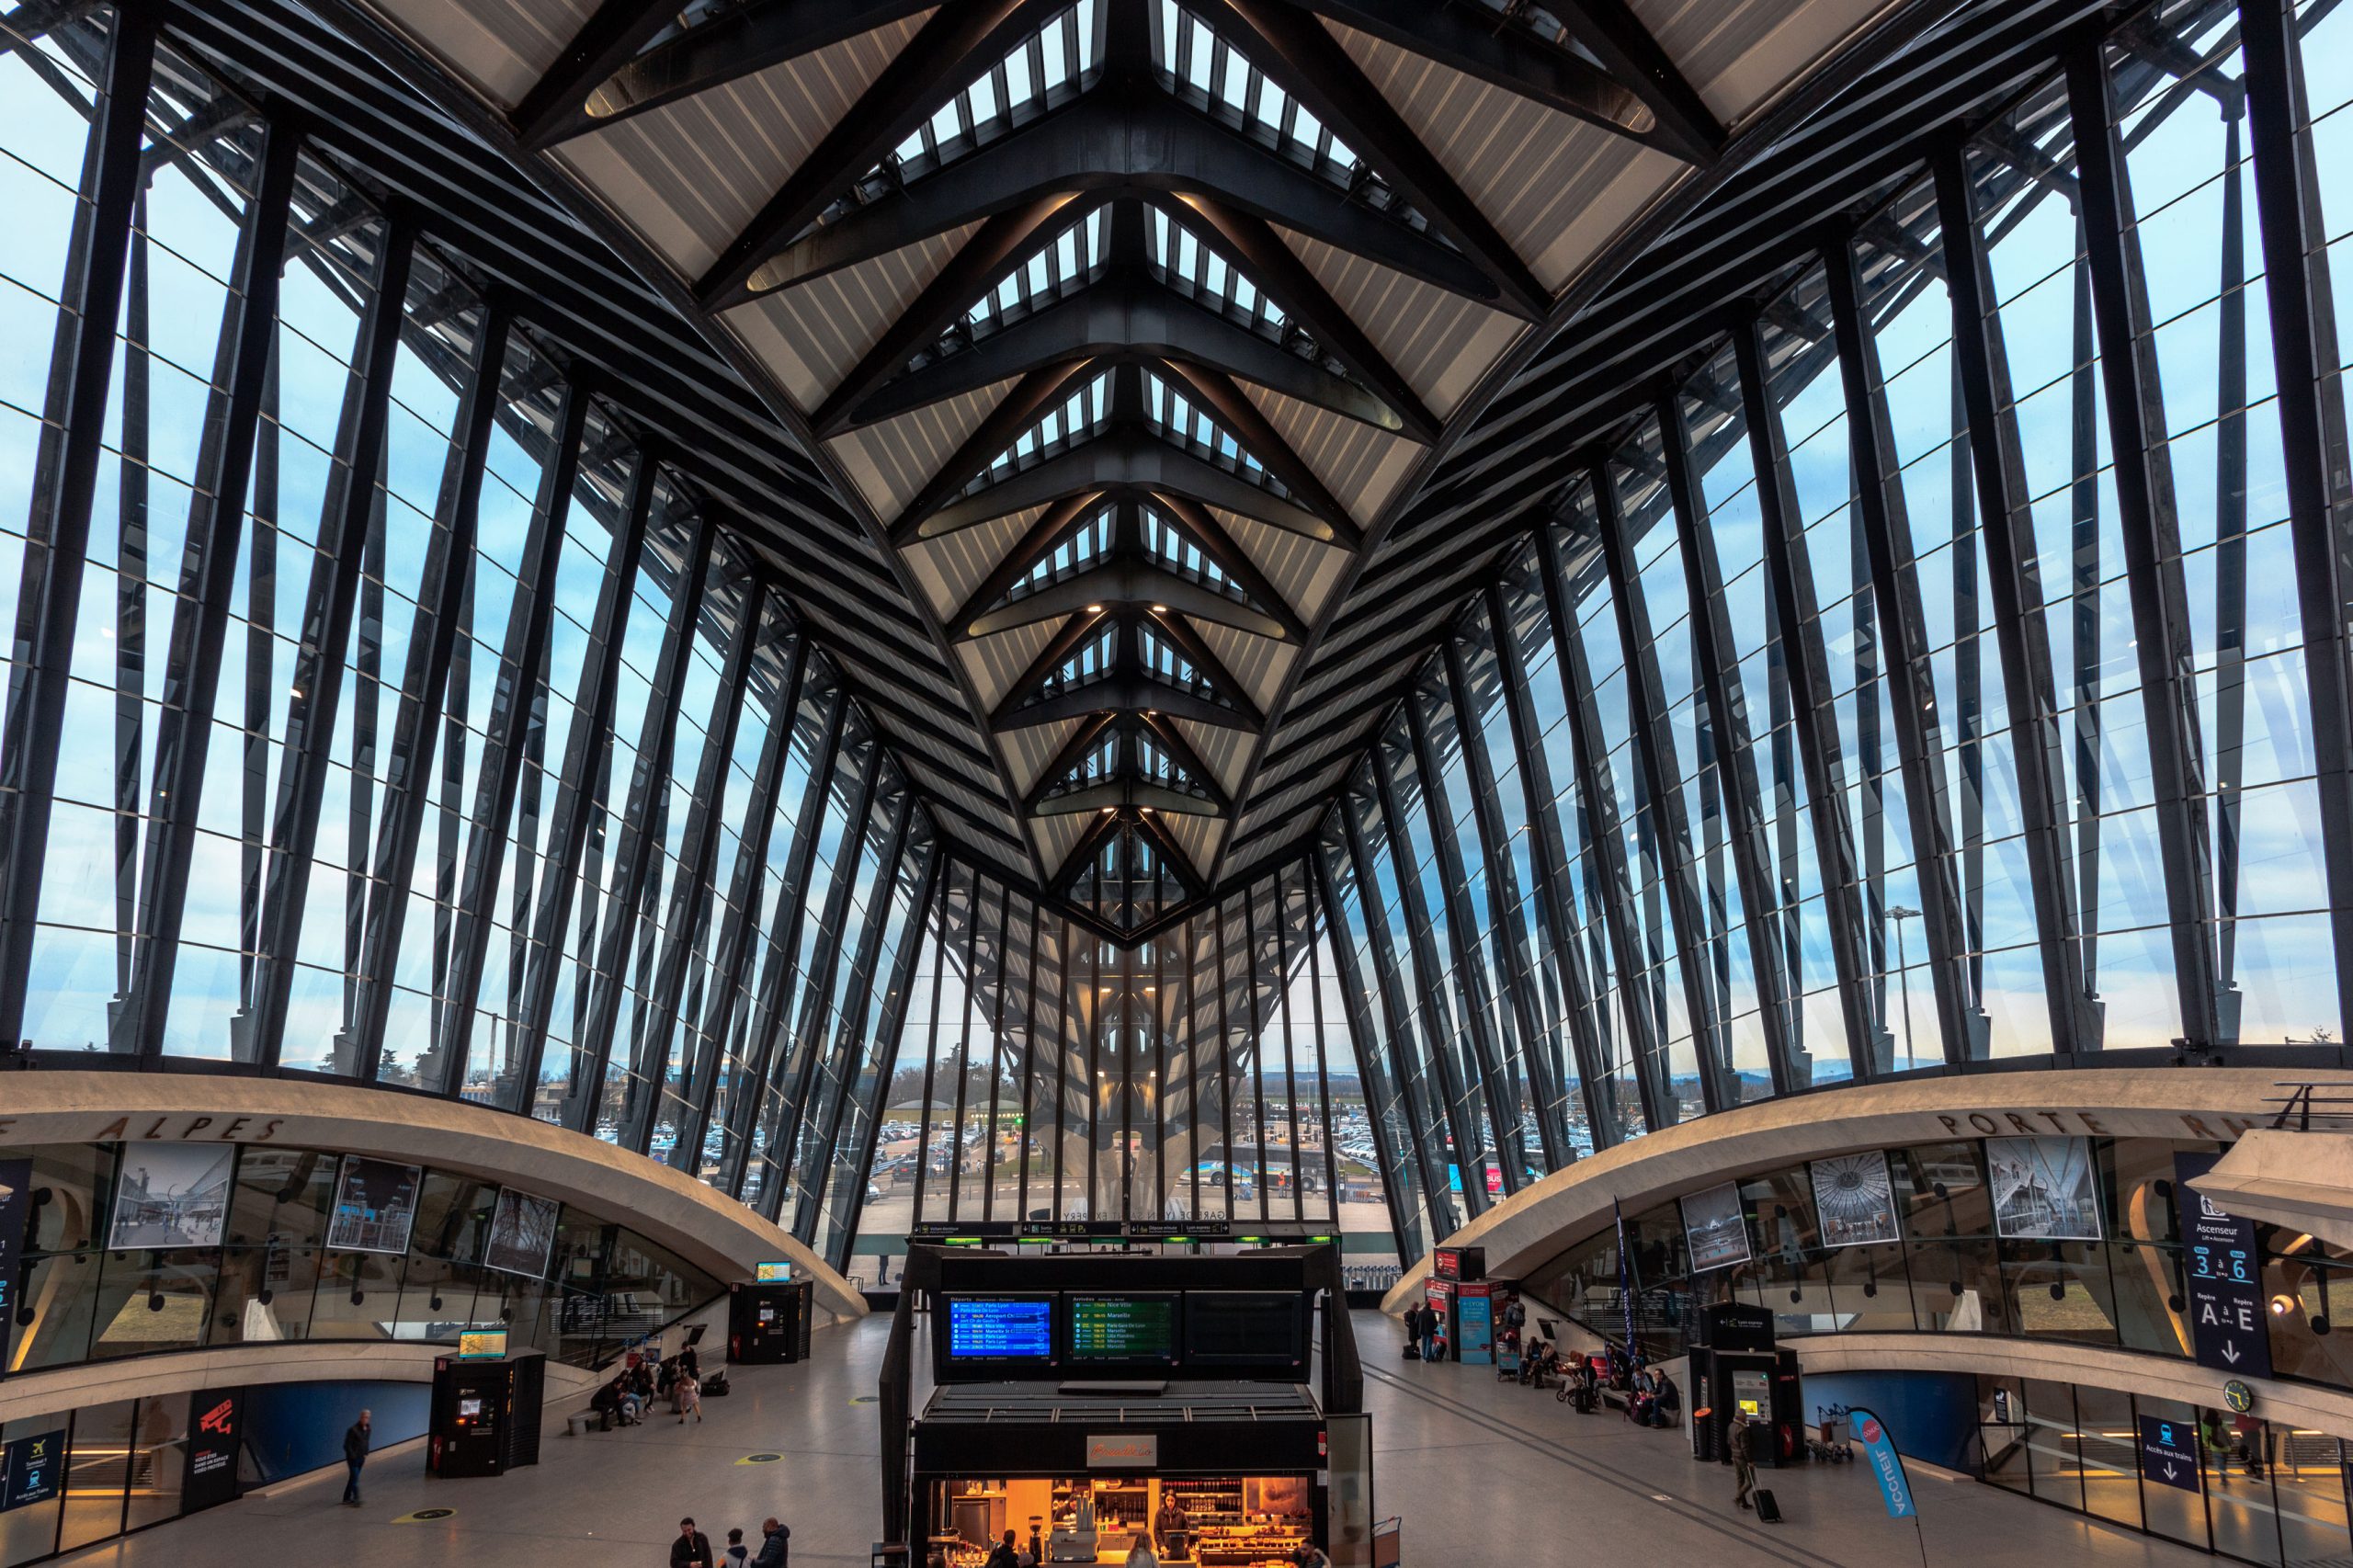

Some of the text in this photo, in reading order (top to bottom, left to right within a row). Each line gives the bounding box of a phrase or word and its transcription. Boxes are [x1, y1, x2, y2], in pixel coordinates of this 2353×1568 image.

[94, 1116, 285, 1141] ALPES
[1938, 1112, 2112, 1135] PORTE
[2196, 1223, 2238, 1235] Ascenseur
[2196, 1255, 2245, 1279] 3 à 6
[2197, 1292, 2216, 1301] Repère
[2234, 1298, 2253, 1306] Repère
[2201, 1303, 2254, 1331] A à E
[2145, 1444, 2192, 1462] Accès aux trains
